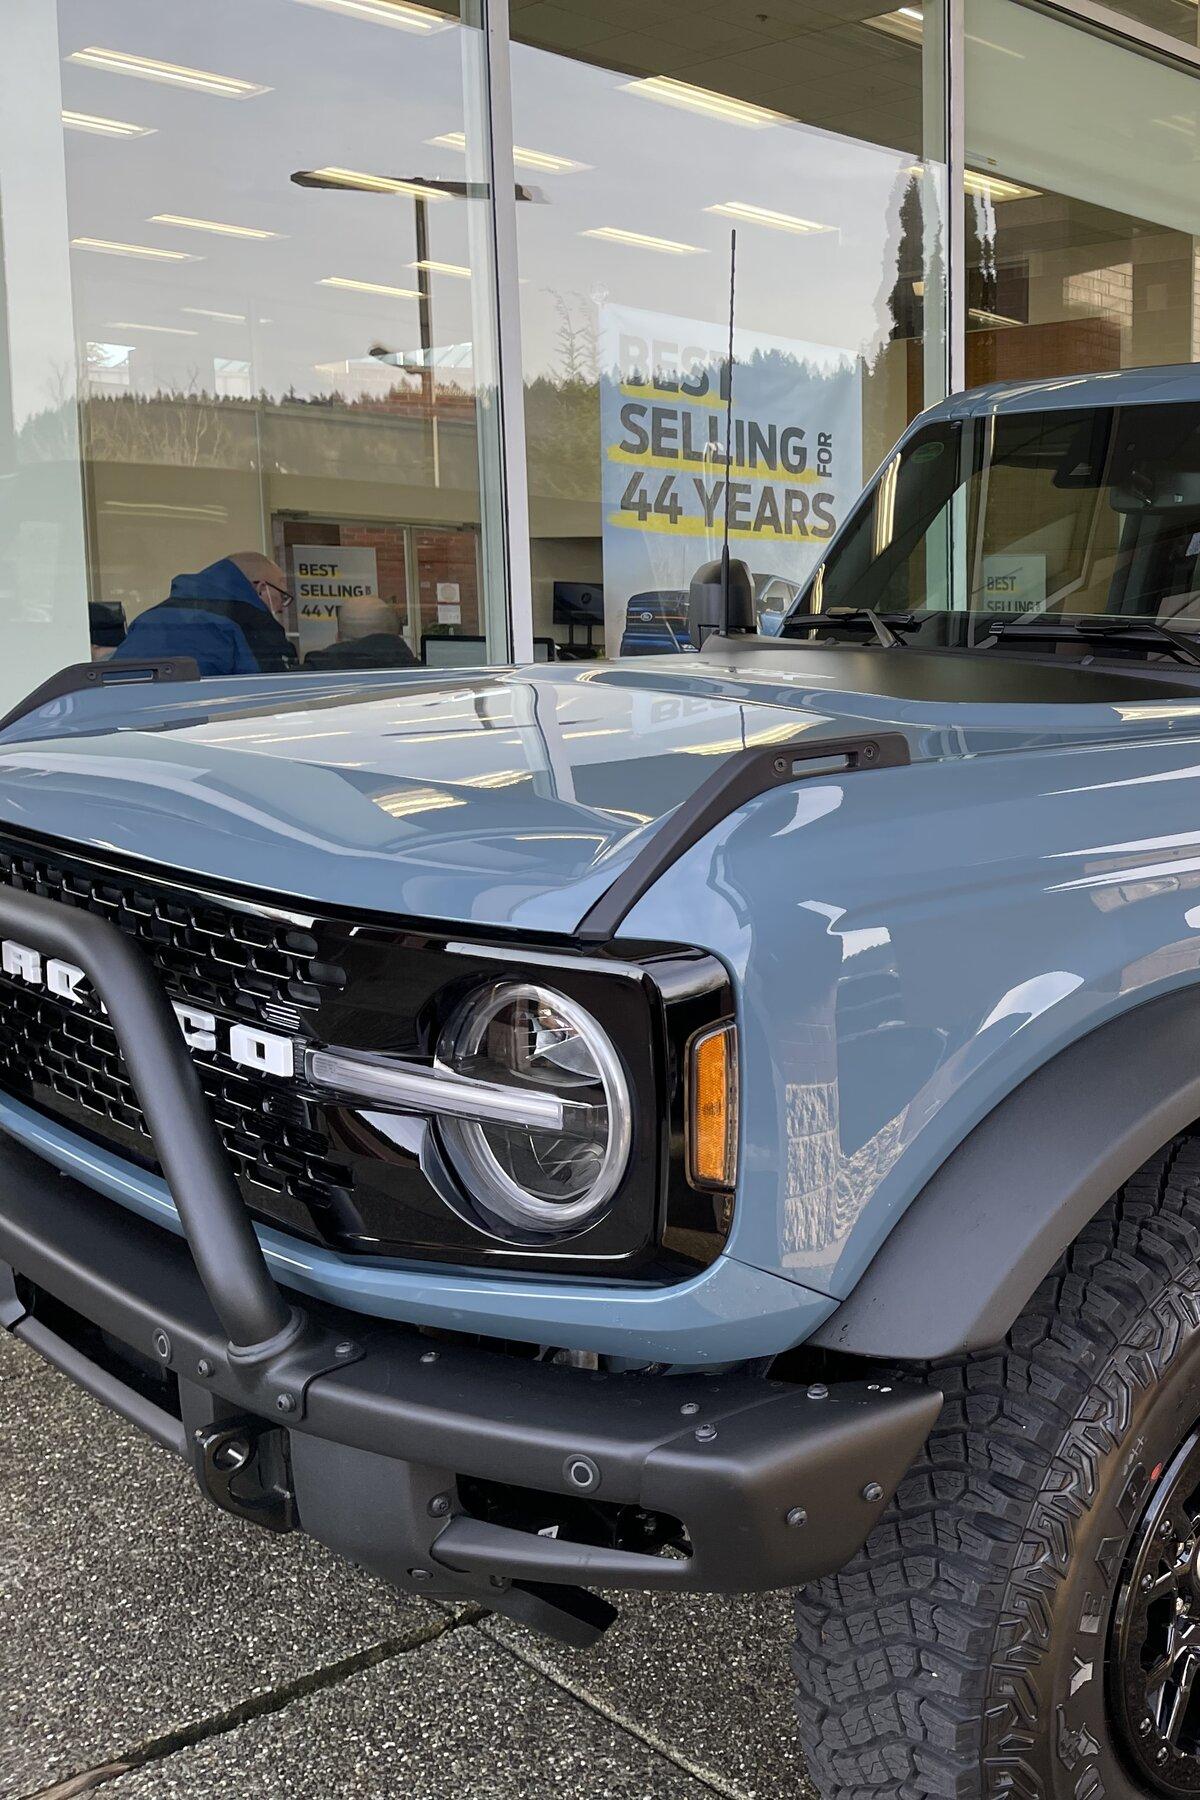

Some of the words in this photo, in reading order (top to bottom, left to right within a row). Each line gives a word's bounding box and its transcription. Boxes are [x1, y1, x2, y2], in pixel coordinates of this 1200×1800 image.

[619, 334, 733, 401] BEST
[619, 403, 808, 474] SELLING
[817, 432, 833, 478] FOR
[620, 472, 683, 525] 44
[693, 478, 836, 538] YEARS
[299, 563, 338, 577] BEST
[300, 584, 363, 597] SELLING
[987, 577, 1016, 590] BEST
[301, 605, 321, 617] 44
